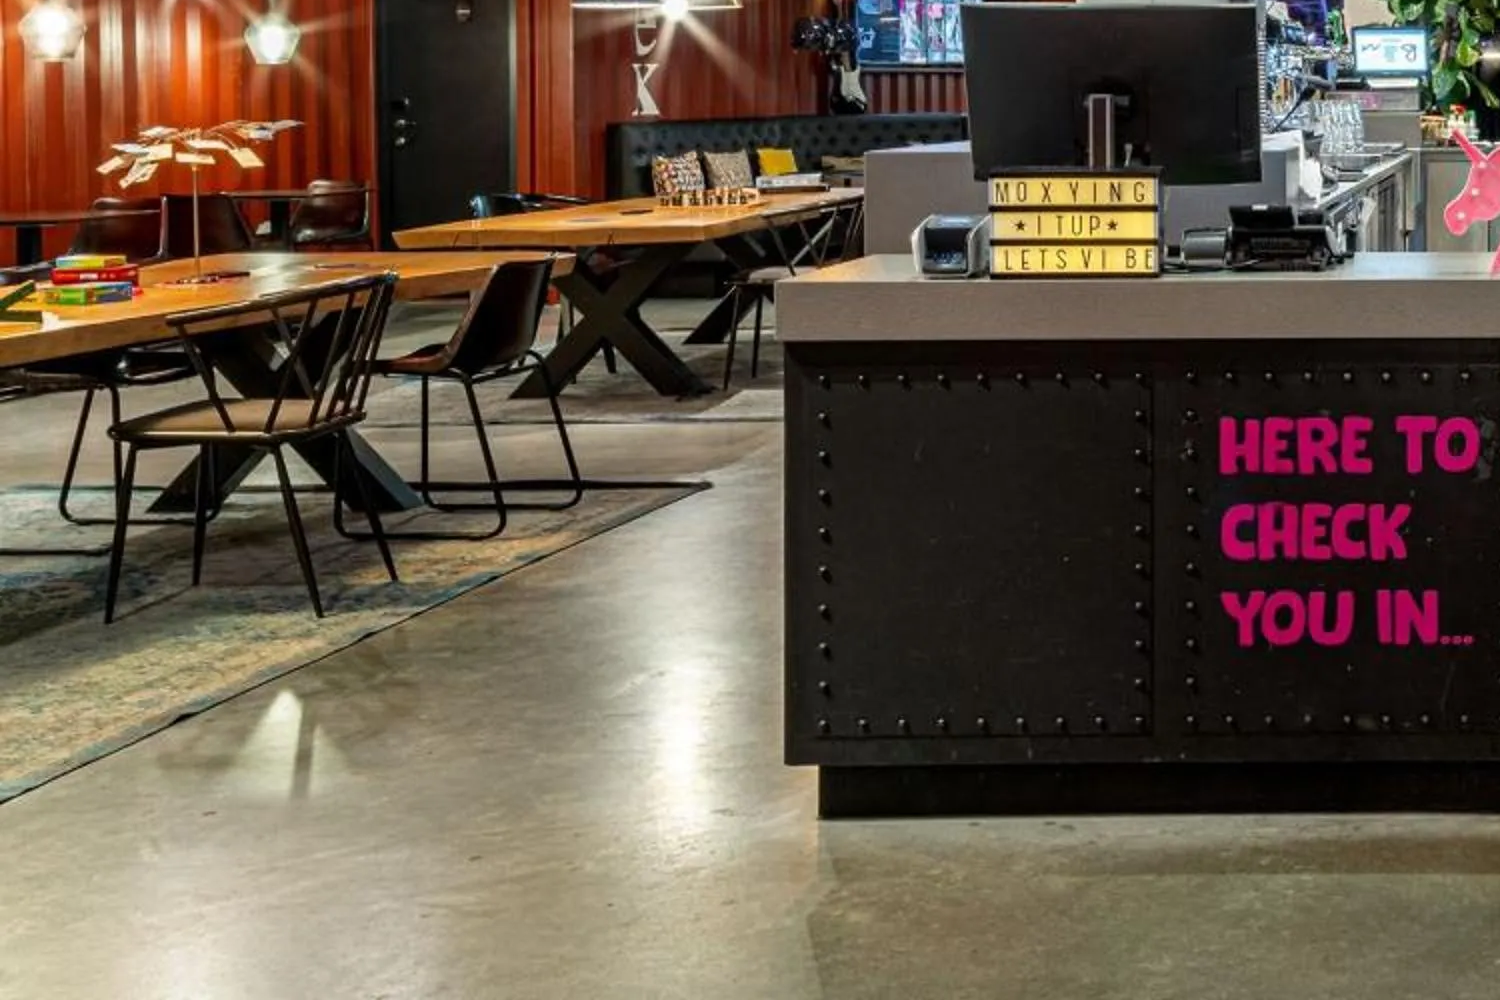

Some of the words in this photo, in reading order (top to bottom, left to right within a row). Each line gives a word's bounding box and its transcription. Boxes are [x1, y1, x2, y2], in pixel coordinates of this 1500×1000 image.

[995, 181, 1145, 203] MOXYING
[1219, 416, 1373, 475] HERE
[1395, 416, 1480, 474] TO
[1220, 503, 1412, 561] CHECK
[1220, 589, 1355, 646] YOU
[1376, 589, 1475, 646] IN...
